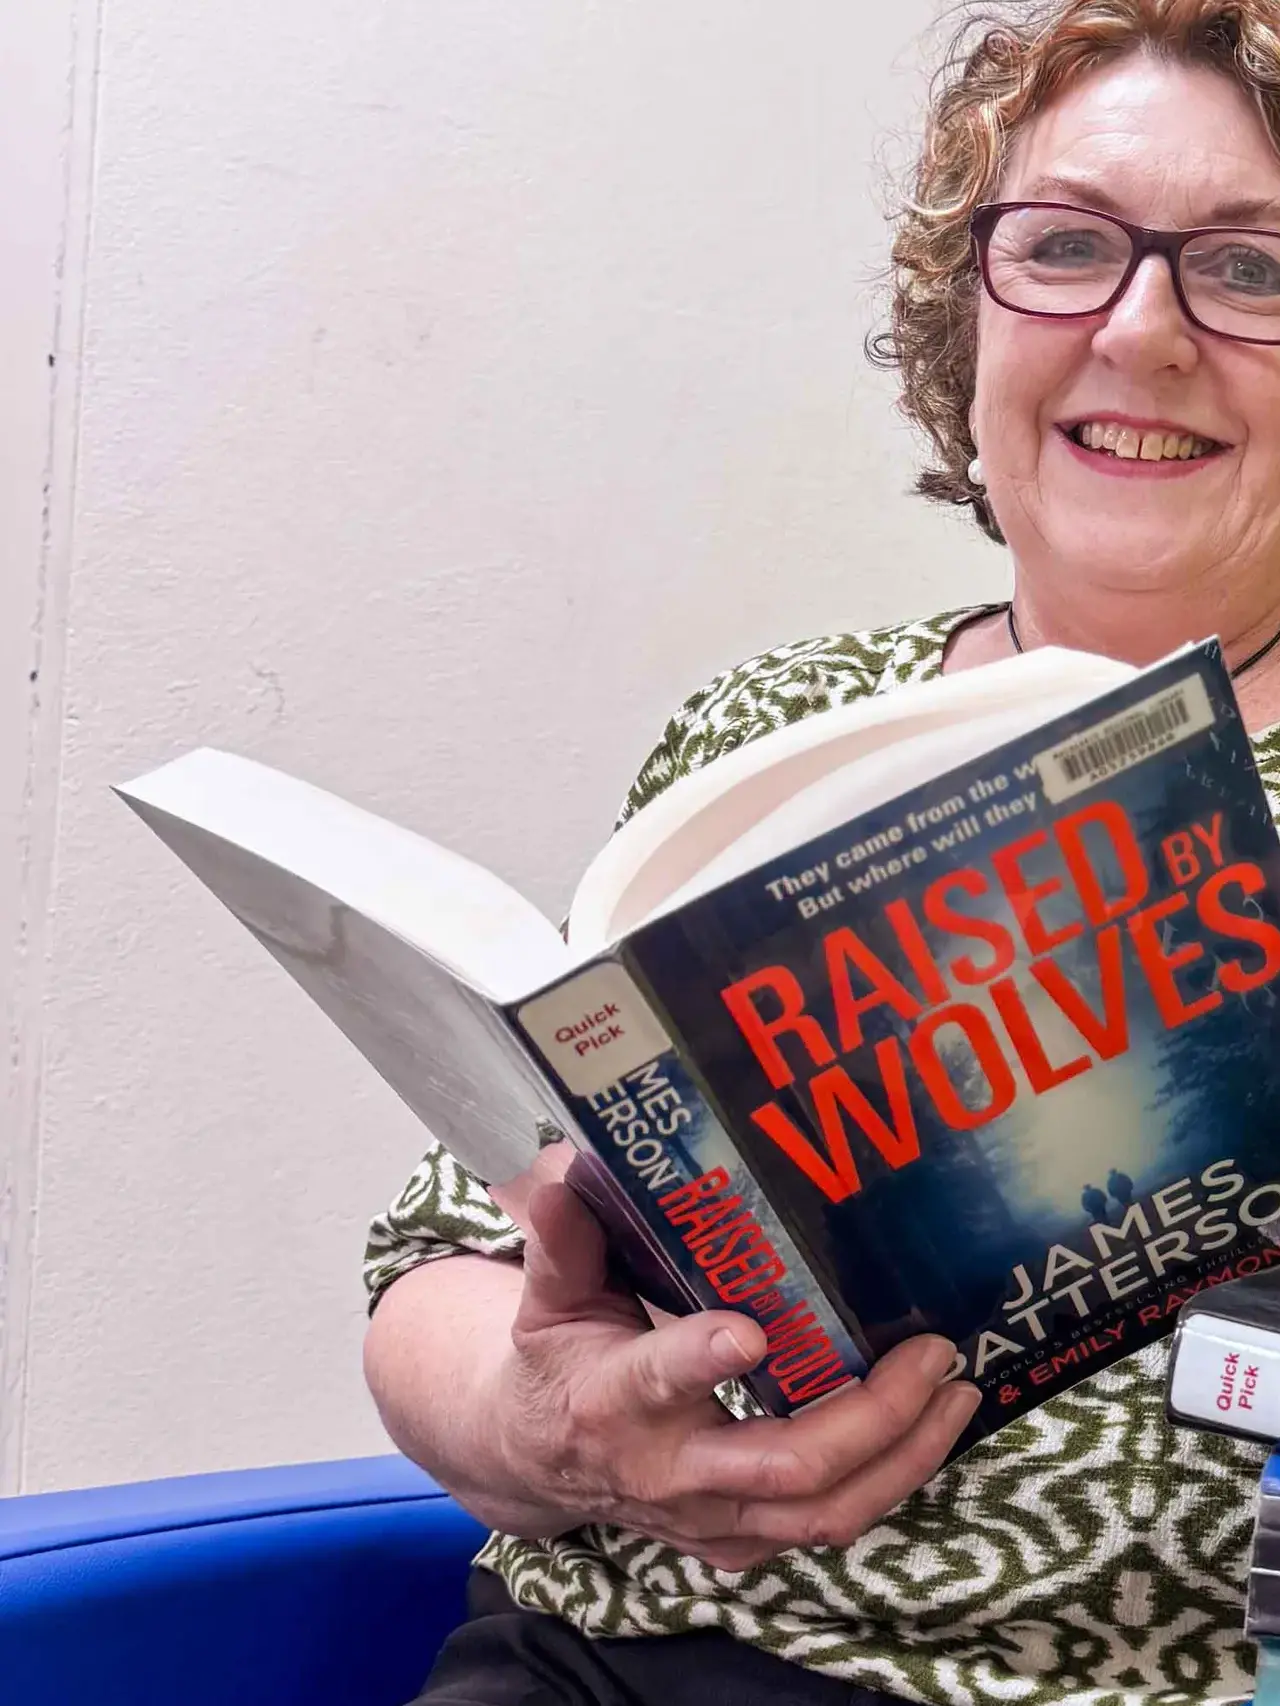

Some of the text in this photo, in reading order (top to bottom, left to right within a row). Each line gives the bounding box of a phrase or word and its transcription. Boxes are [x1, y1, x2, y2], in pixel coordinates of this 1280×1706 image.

[765, 857, 831, 902] They
[835, 824, 904, 869] came
[906, 792, 967, 836] from
[969, 770, 1011, 803] the
[797, 787, 1038, 921] But where will they
[720, 801, 1227, 1090] RAISED BY
[554, 1002, 622, 1044] Quick
[574, 1022, 626, 1057] Pick
[625, 1060, 693, 1137] MES
[656, 1165, 787, 1304] RAISED
[751, 1289, 785, 1318] BY
[1001, 1158, 1246, 1311] JAMES
[997, 1382, 1023, 1406] &
[1028, 1318, 1127, 1387] EMILY
[1215, 1352, 1241, 1412] Quick
[1238, 1364, 1260, 1410] Pick
